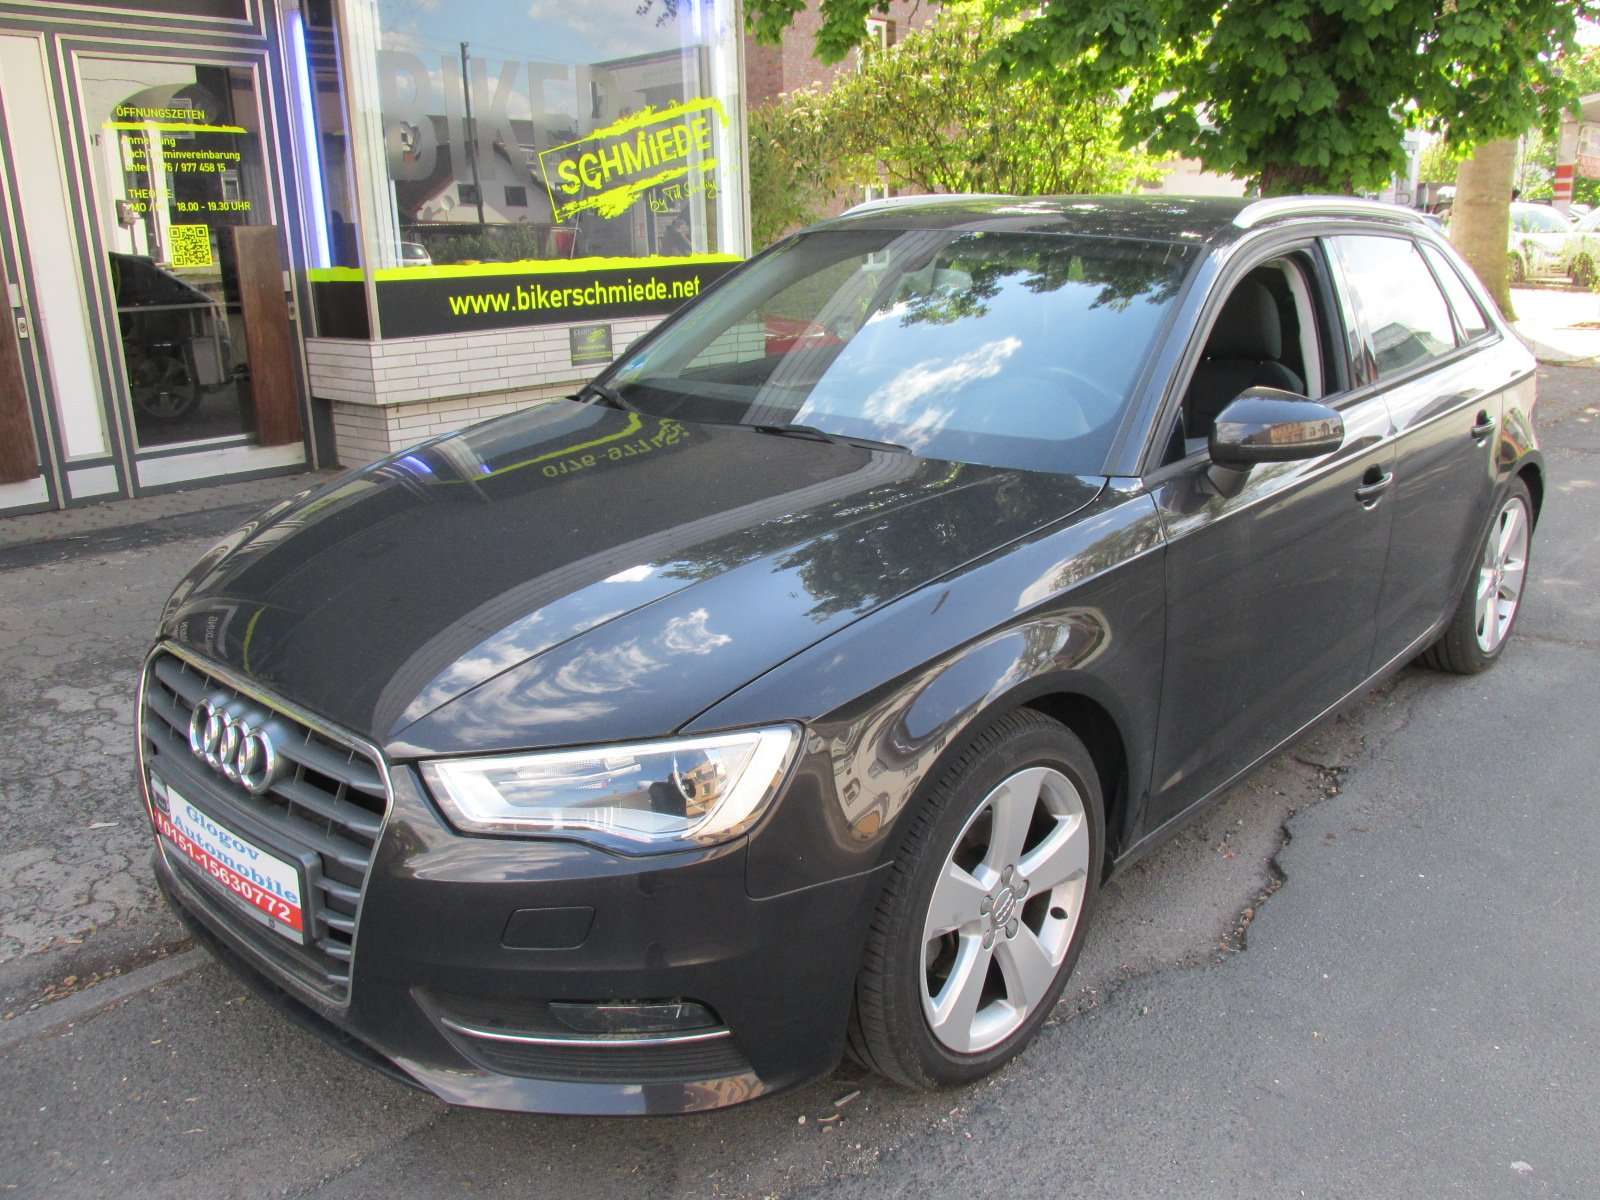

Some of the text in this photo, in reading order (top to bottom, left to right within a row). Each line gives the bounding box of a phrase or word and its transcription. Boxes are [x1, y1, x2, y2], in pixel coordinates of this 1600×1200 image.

[116, 105, 205, 120] ÖFFNUNGSZEITEN
[181, 162, 197, 172] 977
[200, 162, 215, 172] 458
[217, 162, 226, 172] 15
[557, 117, 712, 195] SCHMIEDE
[176, 201, 199, 212] 18.00
[207, 201, 229, 212] 19.30
[230, 200, 252, 211] UHR
[449, 275, 700, 316] www.bikerschmiede.net
[186, 804, 259, 861] Glogov
[173, 815, 298, 904] Automobile
